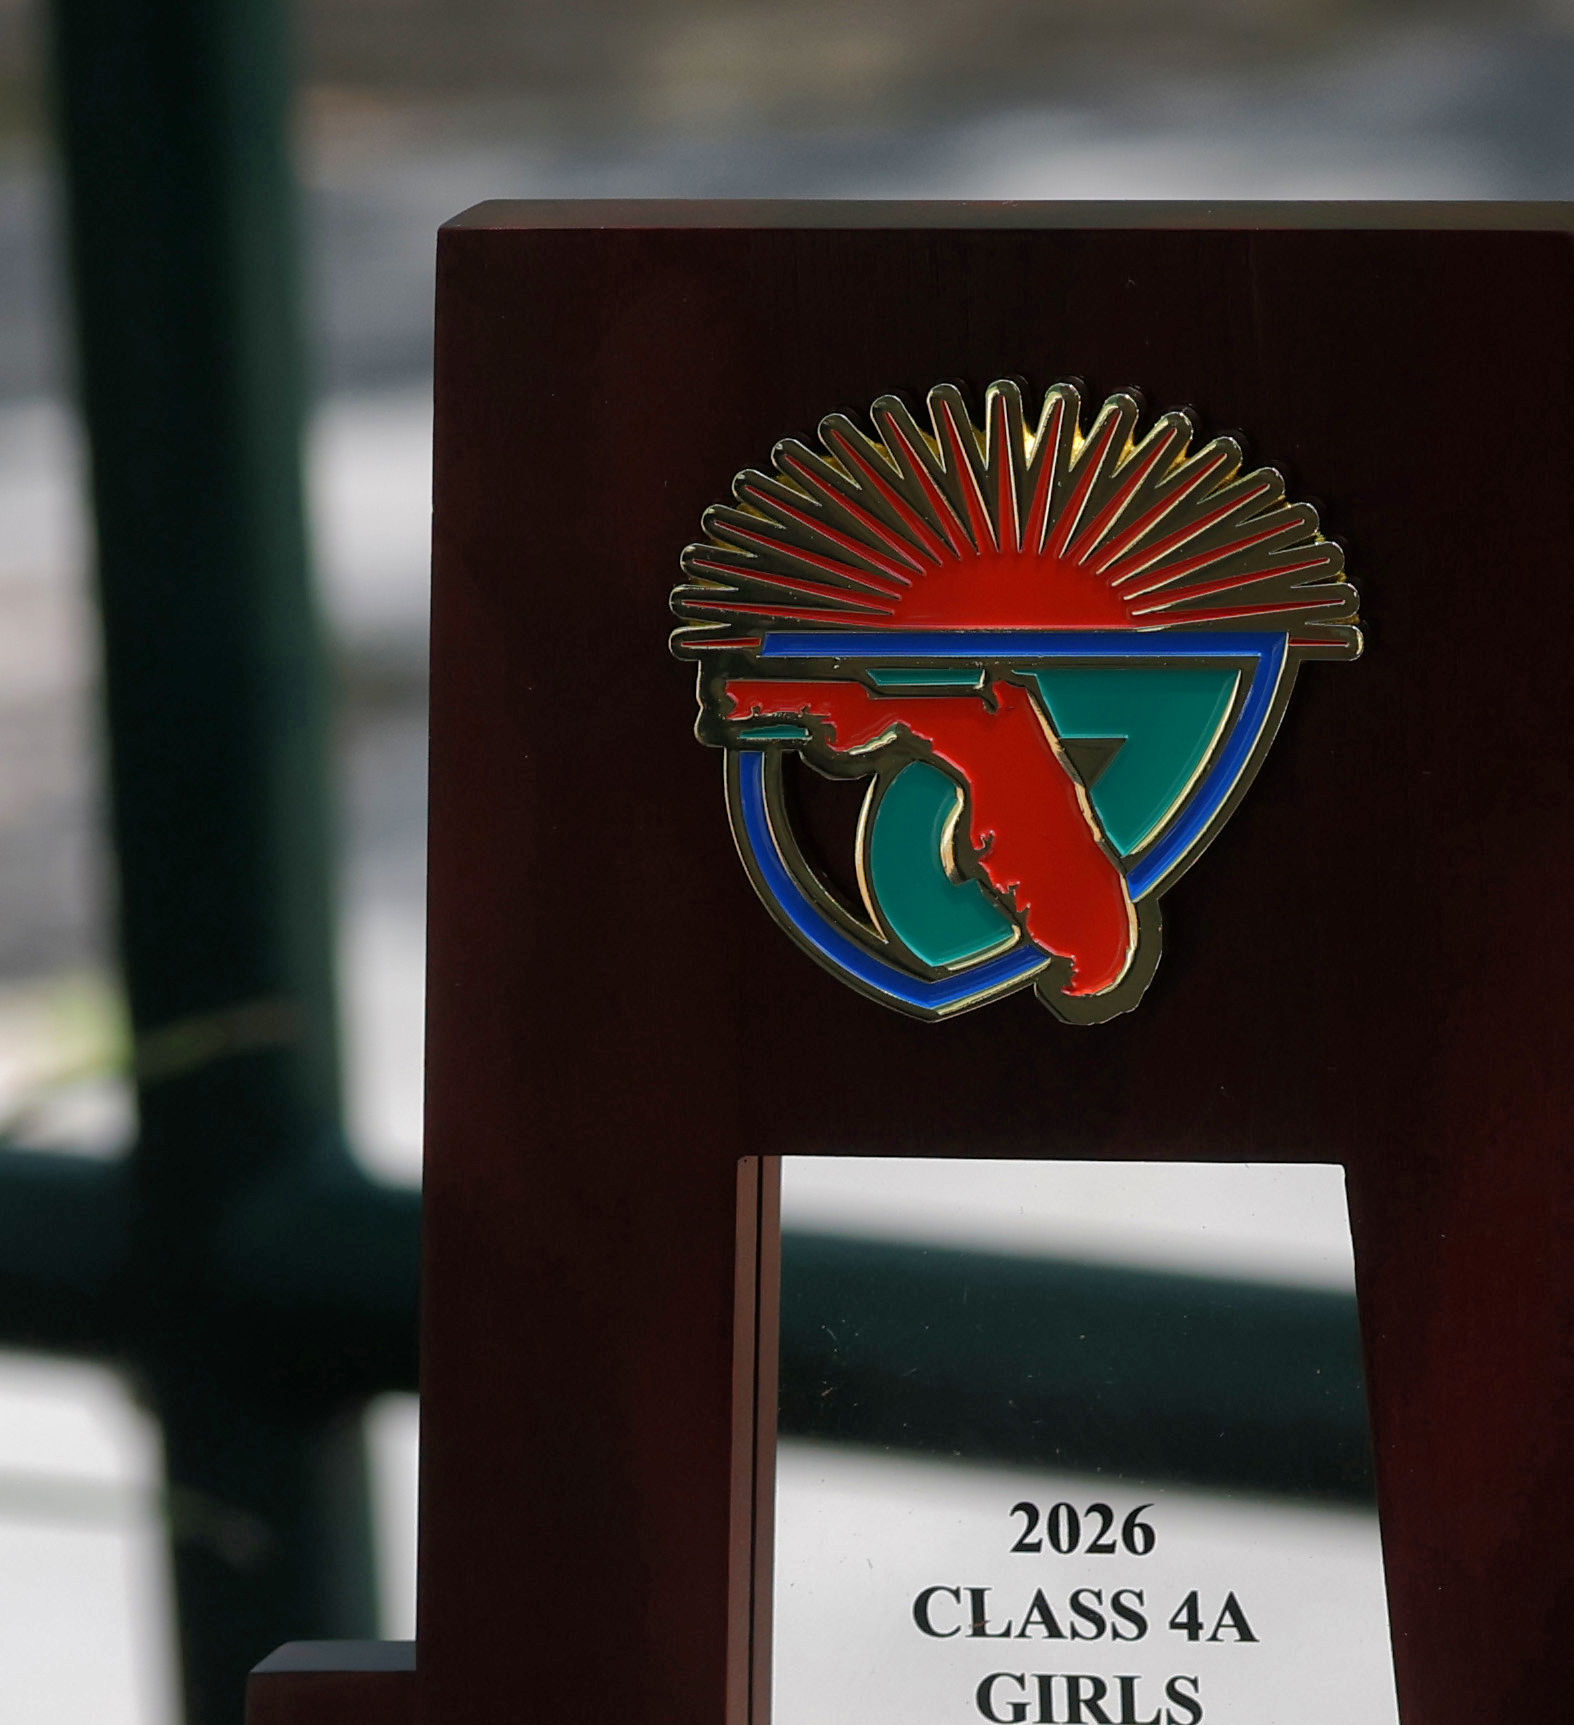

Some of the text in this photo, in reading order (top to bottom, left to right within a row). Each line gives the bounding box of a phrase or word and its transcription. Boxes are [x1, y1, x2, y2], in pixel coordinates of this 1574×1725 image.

[1009, 1501, 1155, 1555] 2026
[912, 1586, 1259, 1642] CLASS 4A
